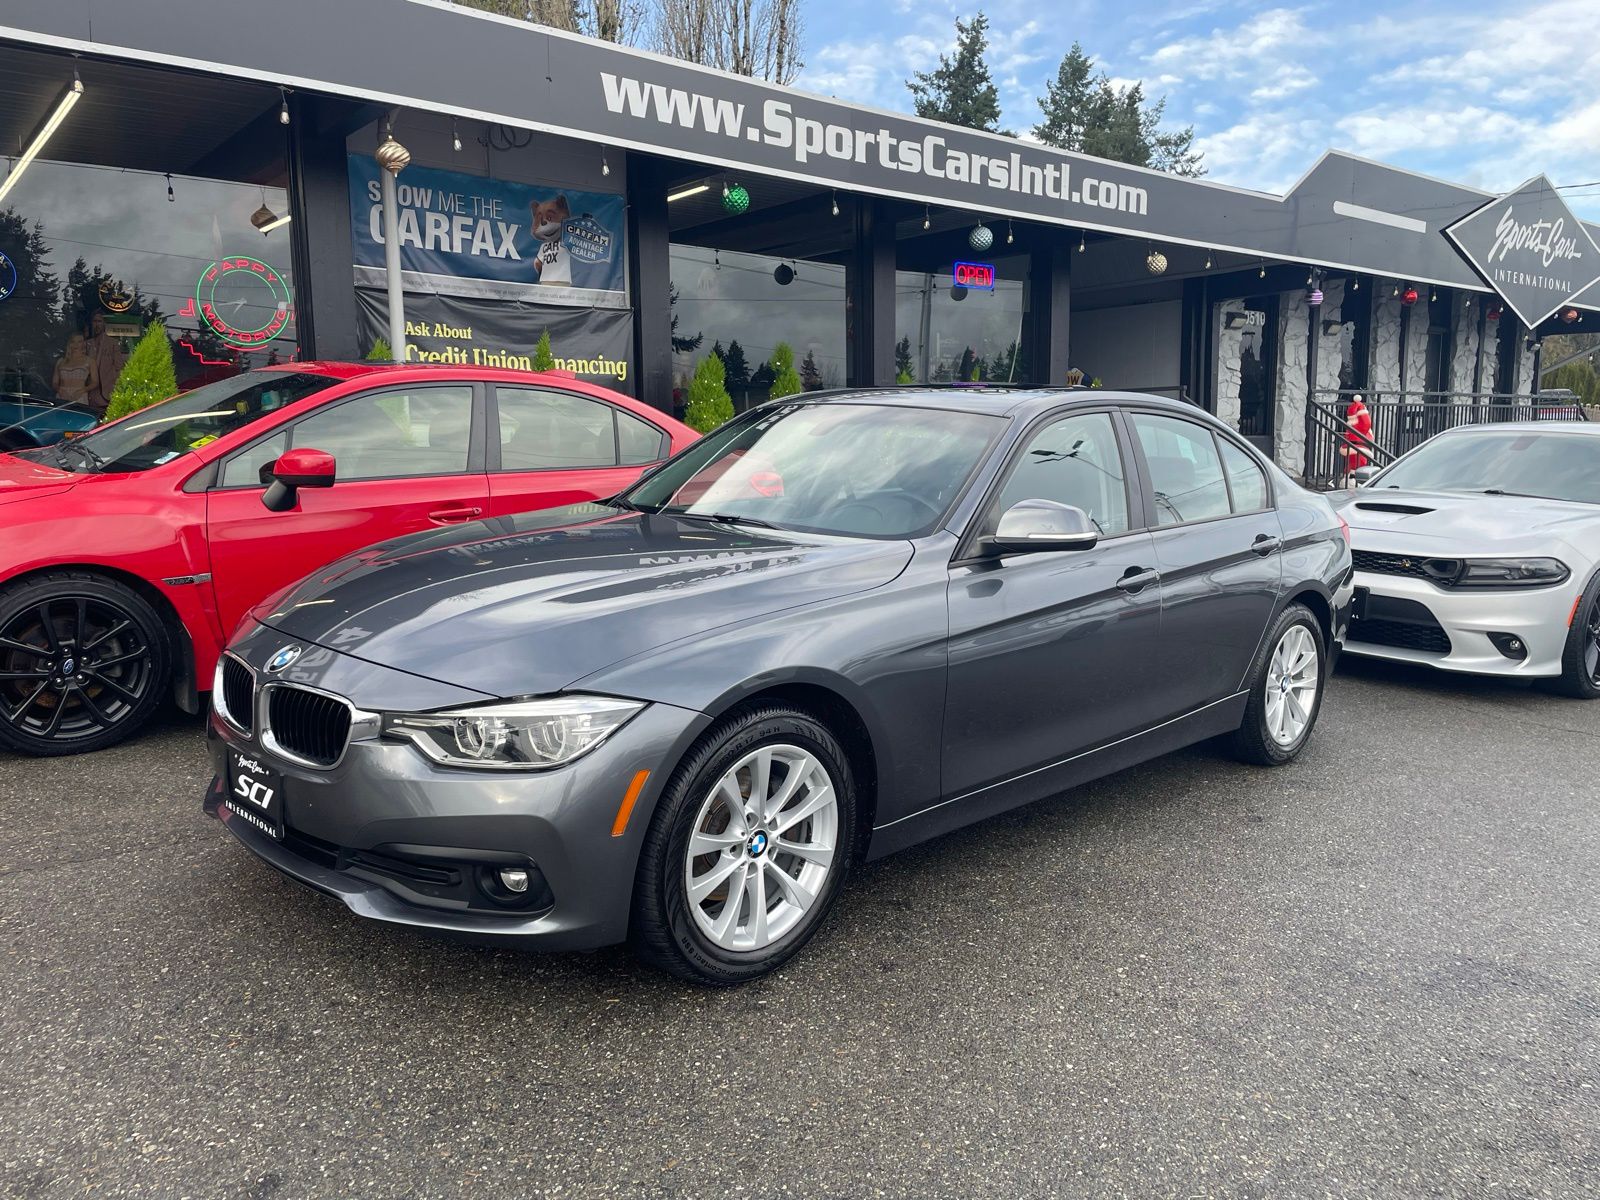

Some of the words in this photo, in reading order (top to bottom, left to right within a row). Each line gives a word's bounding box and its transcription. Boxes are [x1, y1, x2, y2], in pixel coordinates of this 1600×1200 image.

[600, 71, 1148, 216] www.SportsCarsIntl.com
[367, 180, 432, 209] SOW
[438, 190, 466, 214] ME
[470, 196, 503, 219] THE
[369, 203, 522, 261] CARFAX
[567, 225, 609, 246] CARFAX
[568, 236, 604, 255] ADVANTAGE
[1487, 205, 1552, 264] Sports
[1542, 217, 1582, 268] Cars
[542, 241, 560, 254] CAR
[542, 252, 558, 265] FOX
[571, 246, 597, 260] DEALER
[956, 264, 993, 285] OPEN
[1494, 268, 1572, 293] INTERNATIONAL
[202, 303, 287, 343] MOTORING
[405, 321, 430, 337] Ask
[433, 323, 473, 340] About
[405, 343, 468, 364] Credit
[472, 348, 532, 372] Union
[549, 351, 628, 381] nancing
[234, 774, 274, 809] SCI
[225, 800, 277, 838] INTERNATIONAL
